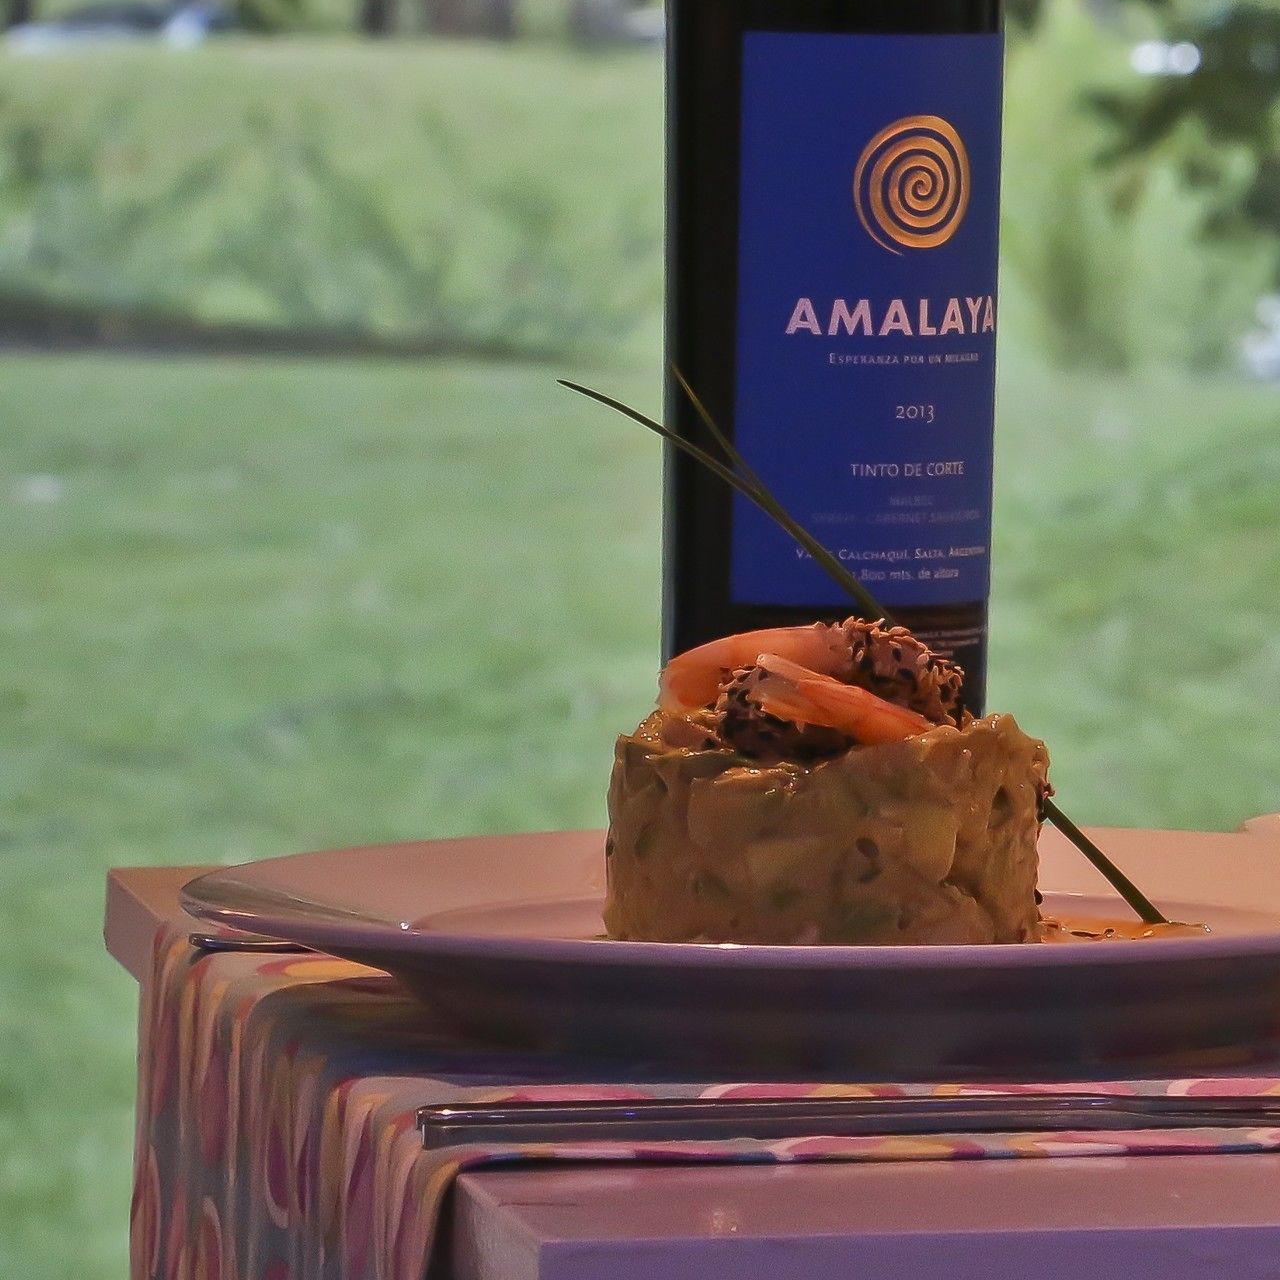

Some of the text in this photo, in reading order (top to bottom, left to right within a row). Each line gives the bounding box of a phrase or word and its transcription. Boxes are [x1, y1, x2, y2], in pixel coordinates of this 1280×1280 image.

[785, 296, 994, 336] AMALAYA
[896, 405, 935, 423] 2013
[851, 461, 965, 478] TINTO DE CORTE
